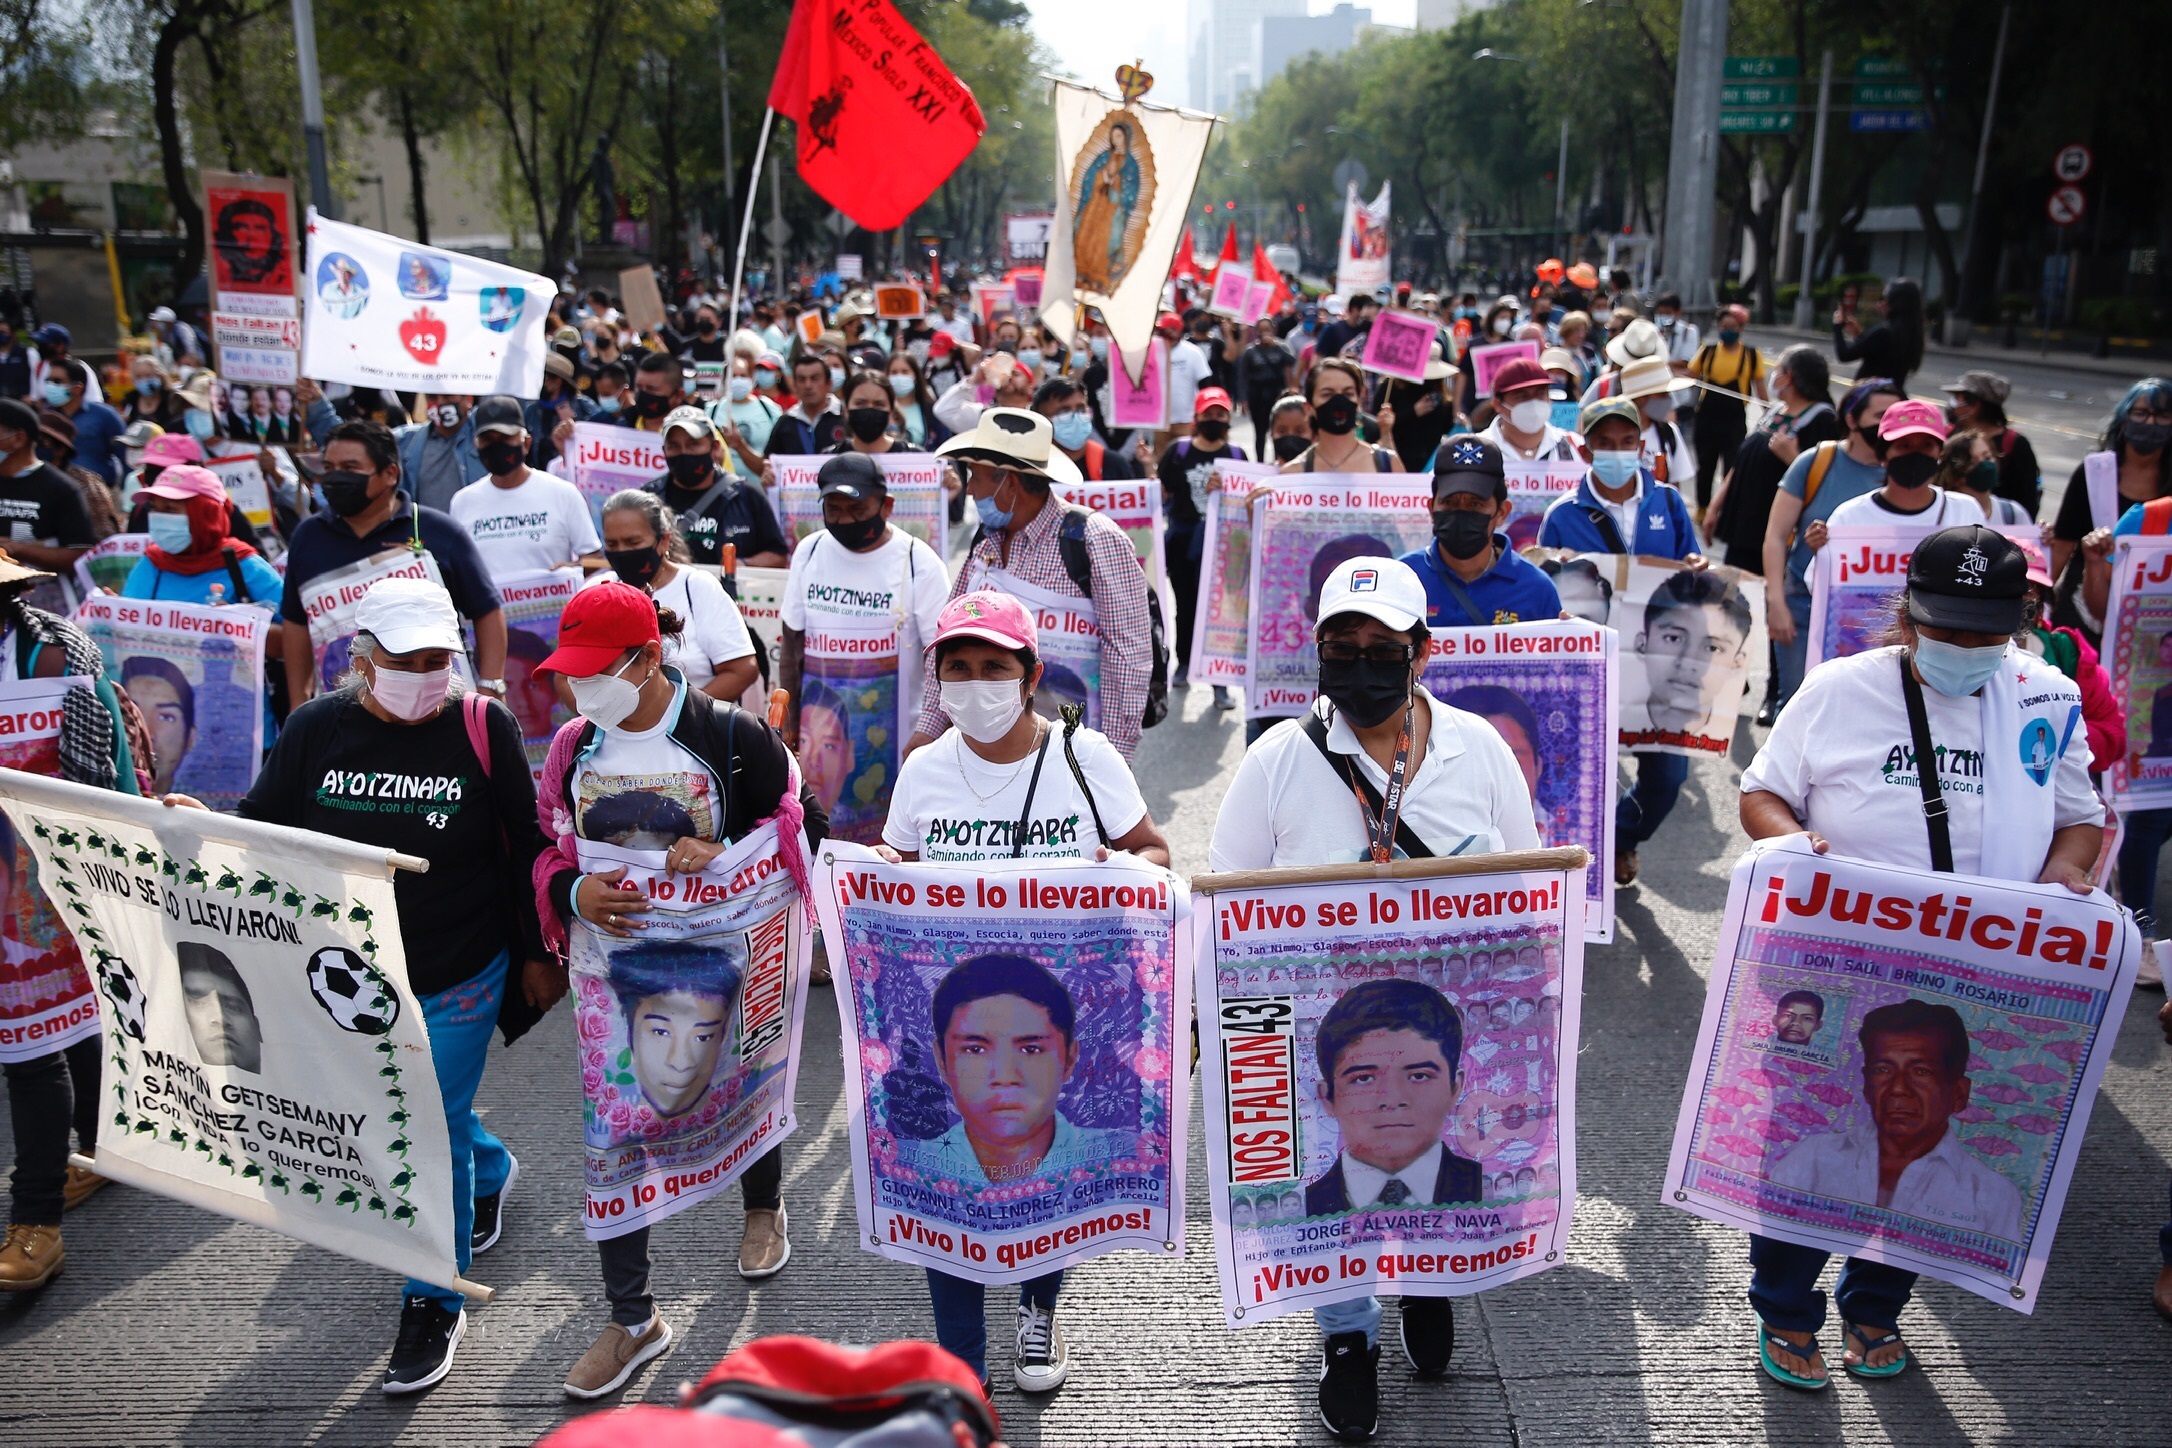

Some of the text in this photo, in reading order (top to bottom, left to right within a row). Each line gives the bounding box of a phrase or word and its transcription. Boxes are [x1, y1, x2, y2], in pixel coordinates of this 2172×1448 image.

[873, 50, 907, 91] SIGLO
[906, 84, 946, 123] XXI
[906, 42, 962, 103] FRANCISCO
[409, 333, 437, 352] 43
[1525, 474, 1541, 490] lo
[1268, 490, 1361, 508] ¡Vivo se lo
[474, 511, 547, 535] AYOTZINAPA
[808, 584, 893, 609] AYOTZINAPA
[118, 608, 139, 623] se
[146, 608, 162, 625] lo
[170, 610, 254, 640] llevaron!
[1037, 609, 1057, 630] lo
[819, 632, 896, 653] llevaron!
[1430, 631, 1601, 655] se lo llevaron!
[1209, 659, 1246, 677] ¡Vivo
[1264, 689, 1306, 707] ¡Vivo
[2051, 693, 2060, 701] LA
[2061, 693, 2075, 702] VOZ
[318, 769, 463, 801] AYOTZINAPA
[617, 776, 679, 788] SABER DONDE
[1953, 782, 1974, 793] con
[316, 796, 415, 814] Caminando con el
[426, 811, 449, 829] 43
[927, 847, 986, 861] Caminando
[80, 862, 303, 945] ¡VIVO SE LO LLEVARON!
[648, 877, 675, 901] lo
[838, 872, 1167, 910] ¡Vivo se lo llevaron!
[645, 919, 685, 931] Escocia,
[689, 916, 722, 930] quiero
[727, 907, 750, 922] saber
[754, 894, 779, 910] dónde
[1221, 880, 1560, 940] ¡Vivo se lo llevaron!
[1760, 871, 2114, 972] ¡Justicia!
[867, 920, 882, 931] Jan
[923, 928, 969, 941] Glasgow,
[976, 929, 1022, 940] Escocia,
[1030, 929, 1066, 941] quiero
[1072, 928, 1102, 940] saber
[1107, 925, 1138, 937] dónde
[1144, 927, 1168, 939] está
[1222, 923, 1560, 957] Yo, Jan Nimmo, Glasgow, Escocia, quiero saber dónde está
[745, 953, 783, 1034] FALTAN
[1804, 953, 2030, 1009] DON SAÚL BRUNO ROSARIO
[1774, 1045, 1798, 1055] BRUNO
[142, 1050, 367, 1137] MARTÍN GETSEMANY
[1229, 1034, 1289, 1124] FALTAN
[143, 1074, 363, 1166] SÁNCHEZ GARCÍA
[687, 1130, 720, 1152] CRUZ
[726, 1087, 770, 1131] MENDOZA
[134, 1090, 377, 1191] ¡Con VIDA lo queremos!
[1232, 1130, 1291, 1182] NOS
[619, 1163, 649, 1178] Carmen
[633, 1184, 656, 1208] lo
[664, 1112, 773, 1196] queremos!
[881, 1177, 1160, 1220] GIOVANNI GALINDREZ GUERRERO
[1705, 1169, 1773, 1196] Fallecido 22
[882, 1194, 902, 1209] Hijo
[906, 1201, 917, 1211] de
[920, 1205, 939, 1218] José
[943, 1212, 978, 1229] Alfredo
[1026, 1211, 1054, 1224] Elena
[1068, 1203, 1080, 1213] 19
[1120, 1191, 1159, 1203] Arcelia
[889, 1208, 1152, 1269] ¡Vivo lo queremos!
[1245, 1220, 1547, 1262] Hijo de Epifanio y Blanca 19 años Juan Escudero
[1297, 1211, 1501, 1243] JORGE ÁLVAREZ NAVA
[1855, 1209, 2006, 1256] Memoria Verdad Justicia
[1254, 1233, 1538, 1302] ¡Vivo lo queremos!
